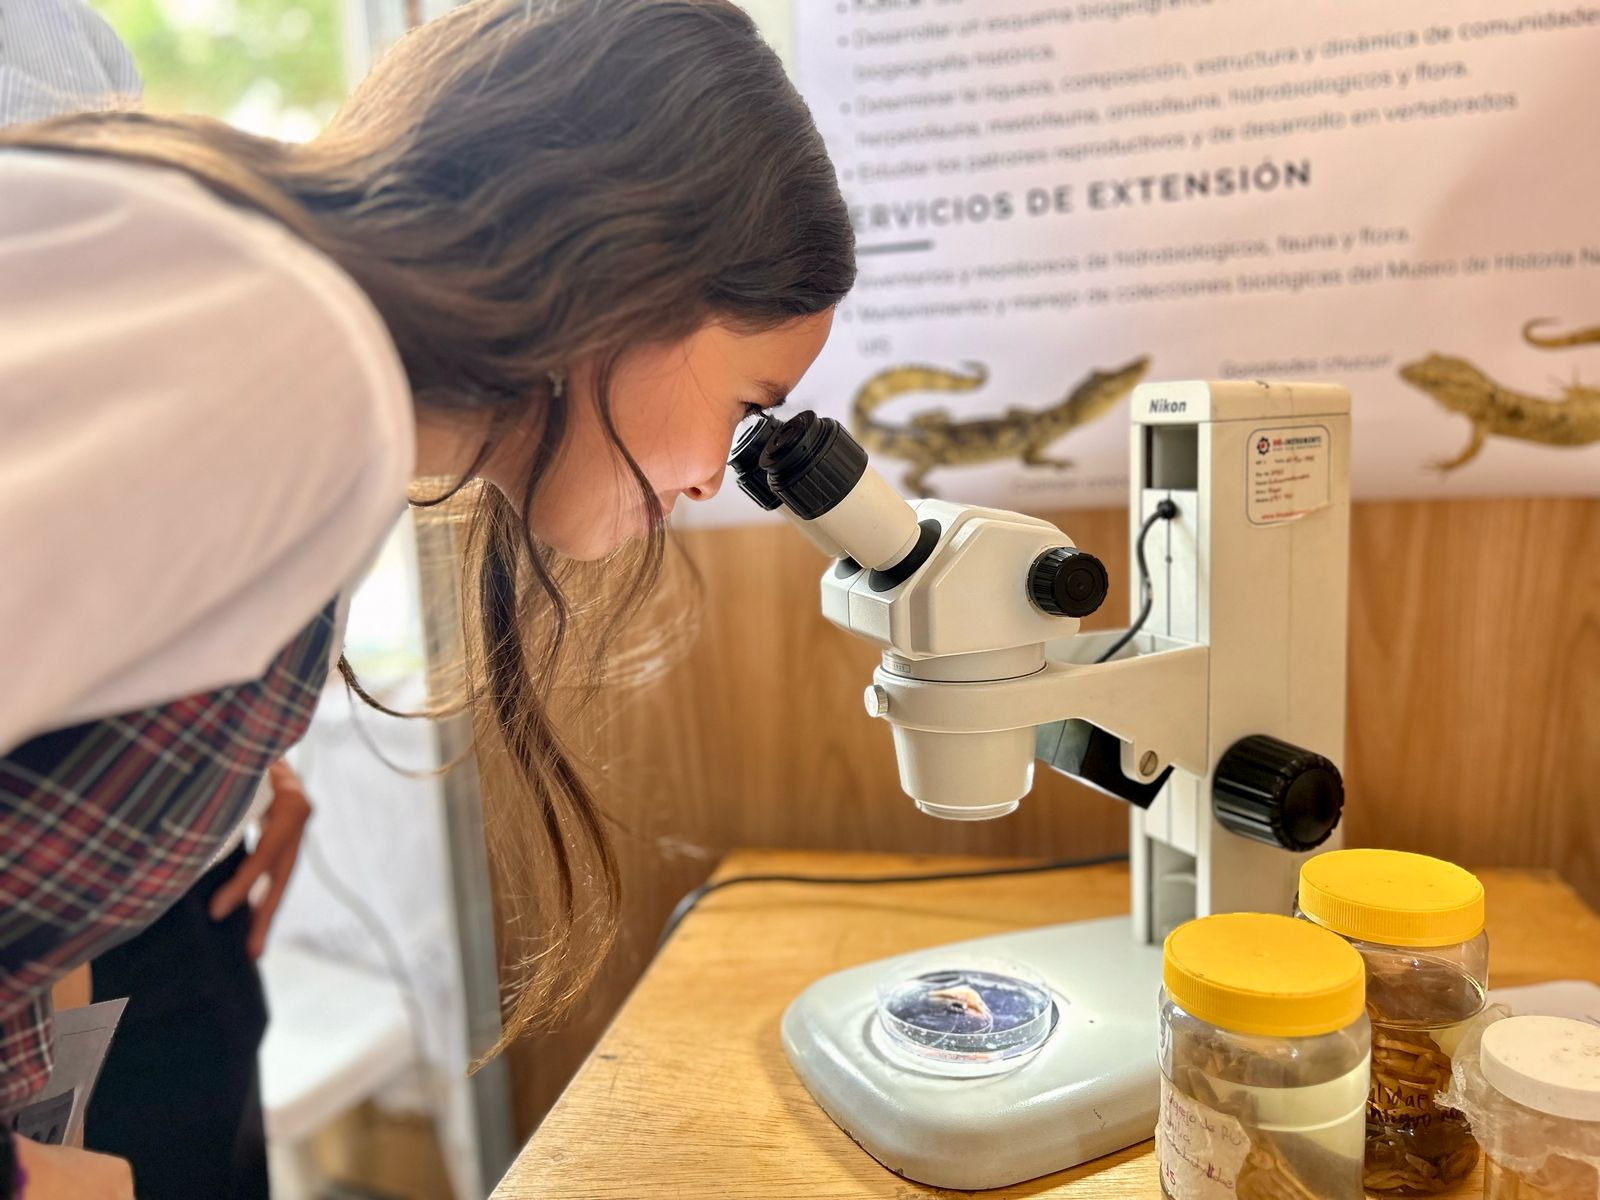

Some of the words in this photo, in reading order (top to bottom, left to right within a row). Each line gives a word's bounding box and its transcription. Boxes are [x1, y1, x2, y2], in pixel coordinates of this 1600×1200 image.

[1193, 48, 1299, 76] estructura
[1303, 47, 1316, 65] y
[1422, 25, 1453, 46] de
[1397, 70, 1412, 90] y
[1207, 124, 1236, 145] de
[1240, 108, 1347, 142] desarrollo
[1350, 107, 1381, 128] en
[1382, 91, 1520, 122] vertebrados
[849, 191, 1015, 234] ERVICIOS
[1026, 184, 1075, 217] DE
[1087, 156, 1311, 210] EXTENSIÓN
[1276, 232, 1338, 254] fauna
[1340, 232, 1356, 254] y
[1346, 259, 1383, 285] del
[1386, 258, 1459, 281] Museo
[1461, 253, 1490, 278] de
[1494, 248, 1575, 274] Historia
[1149, 398, 1187, 413] Nikon
